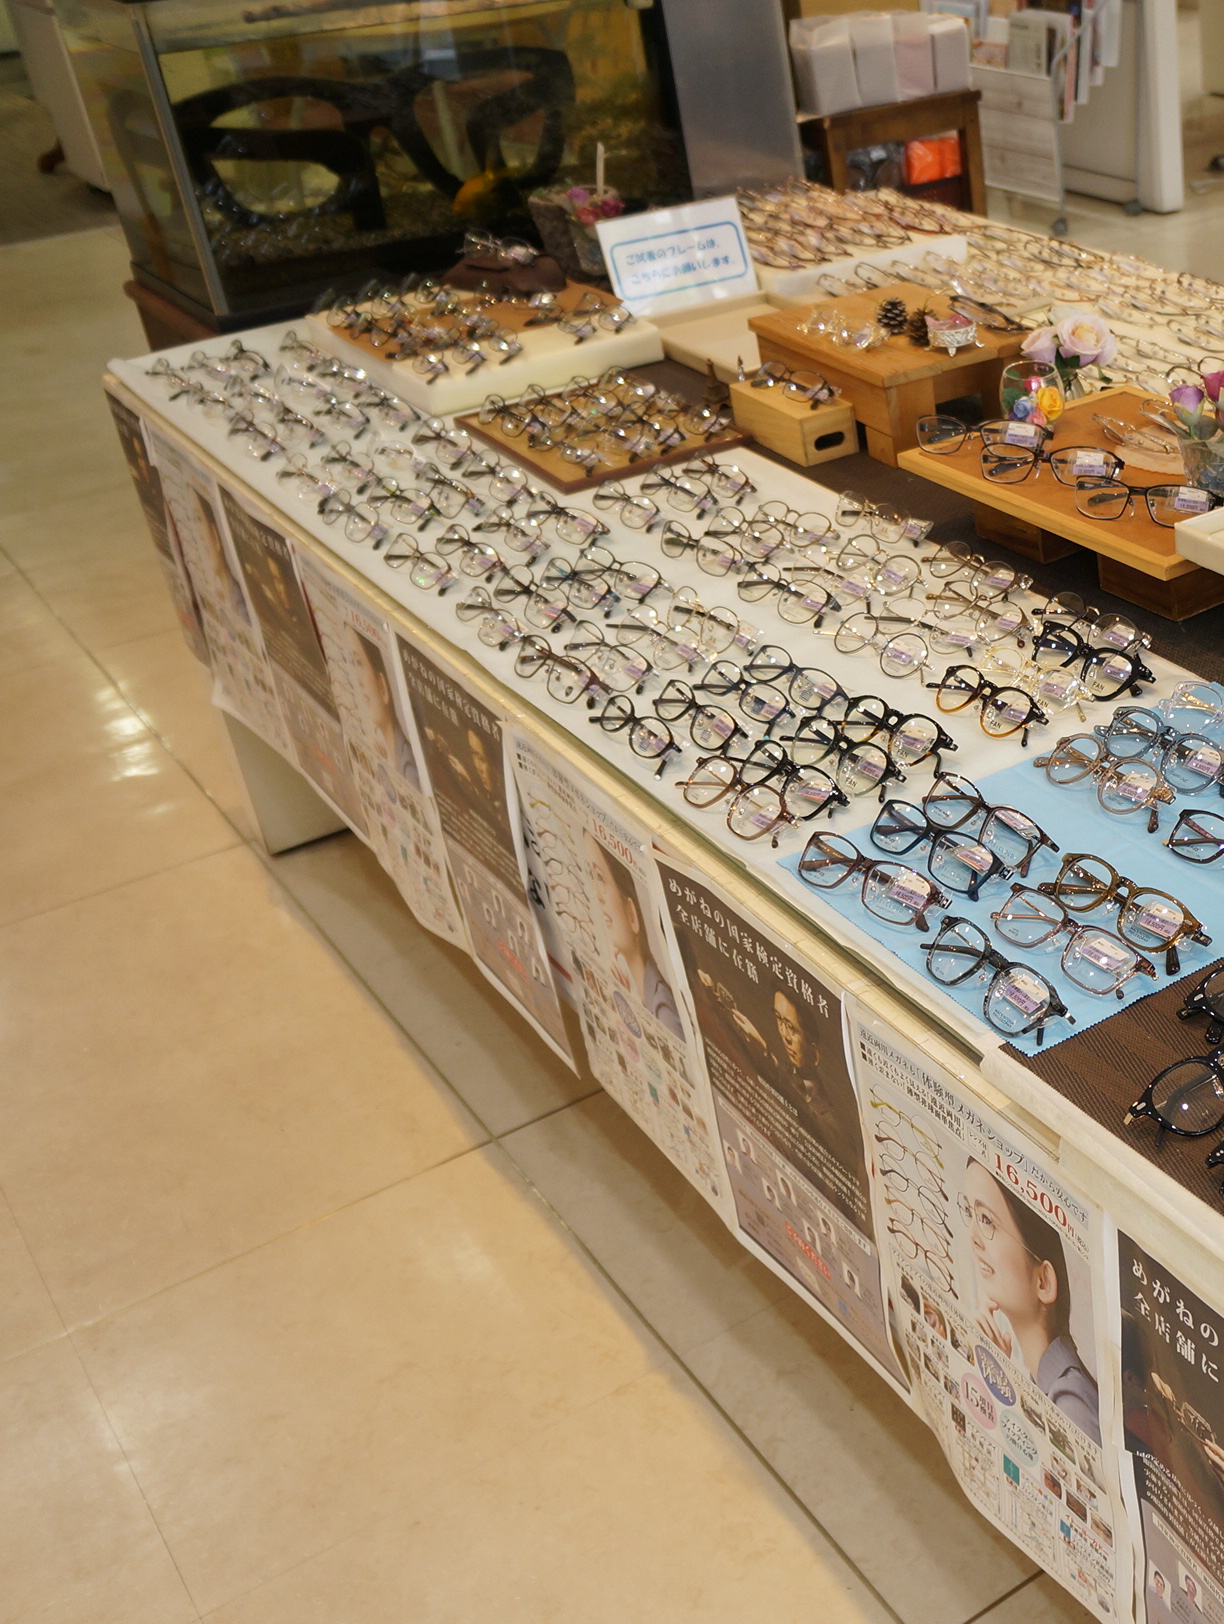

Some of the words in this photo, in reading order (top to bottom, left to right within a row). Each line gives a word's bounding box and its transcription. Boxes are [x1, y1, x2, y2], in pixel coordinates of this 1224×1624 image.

[666, 875, 831, 1020] めがねの国家検定資格者
[674, 902, 760, 985] 全店舗に在籍
[963, 1379, 980, 1409] 15
